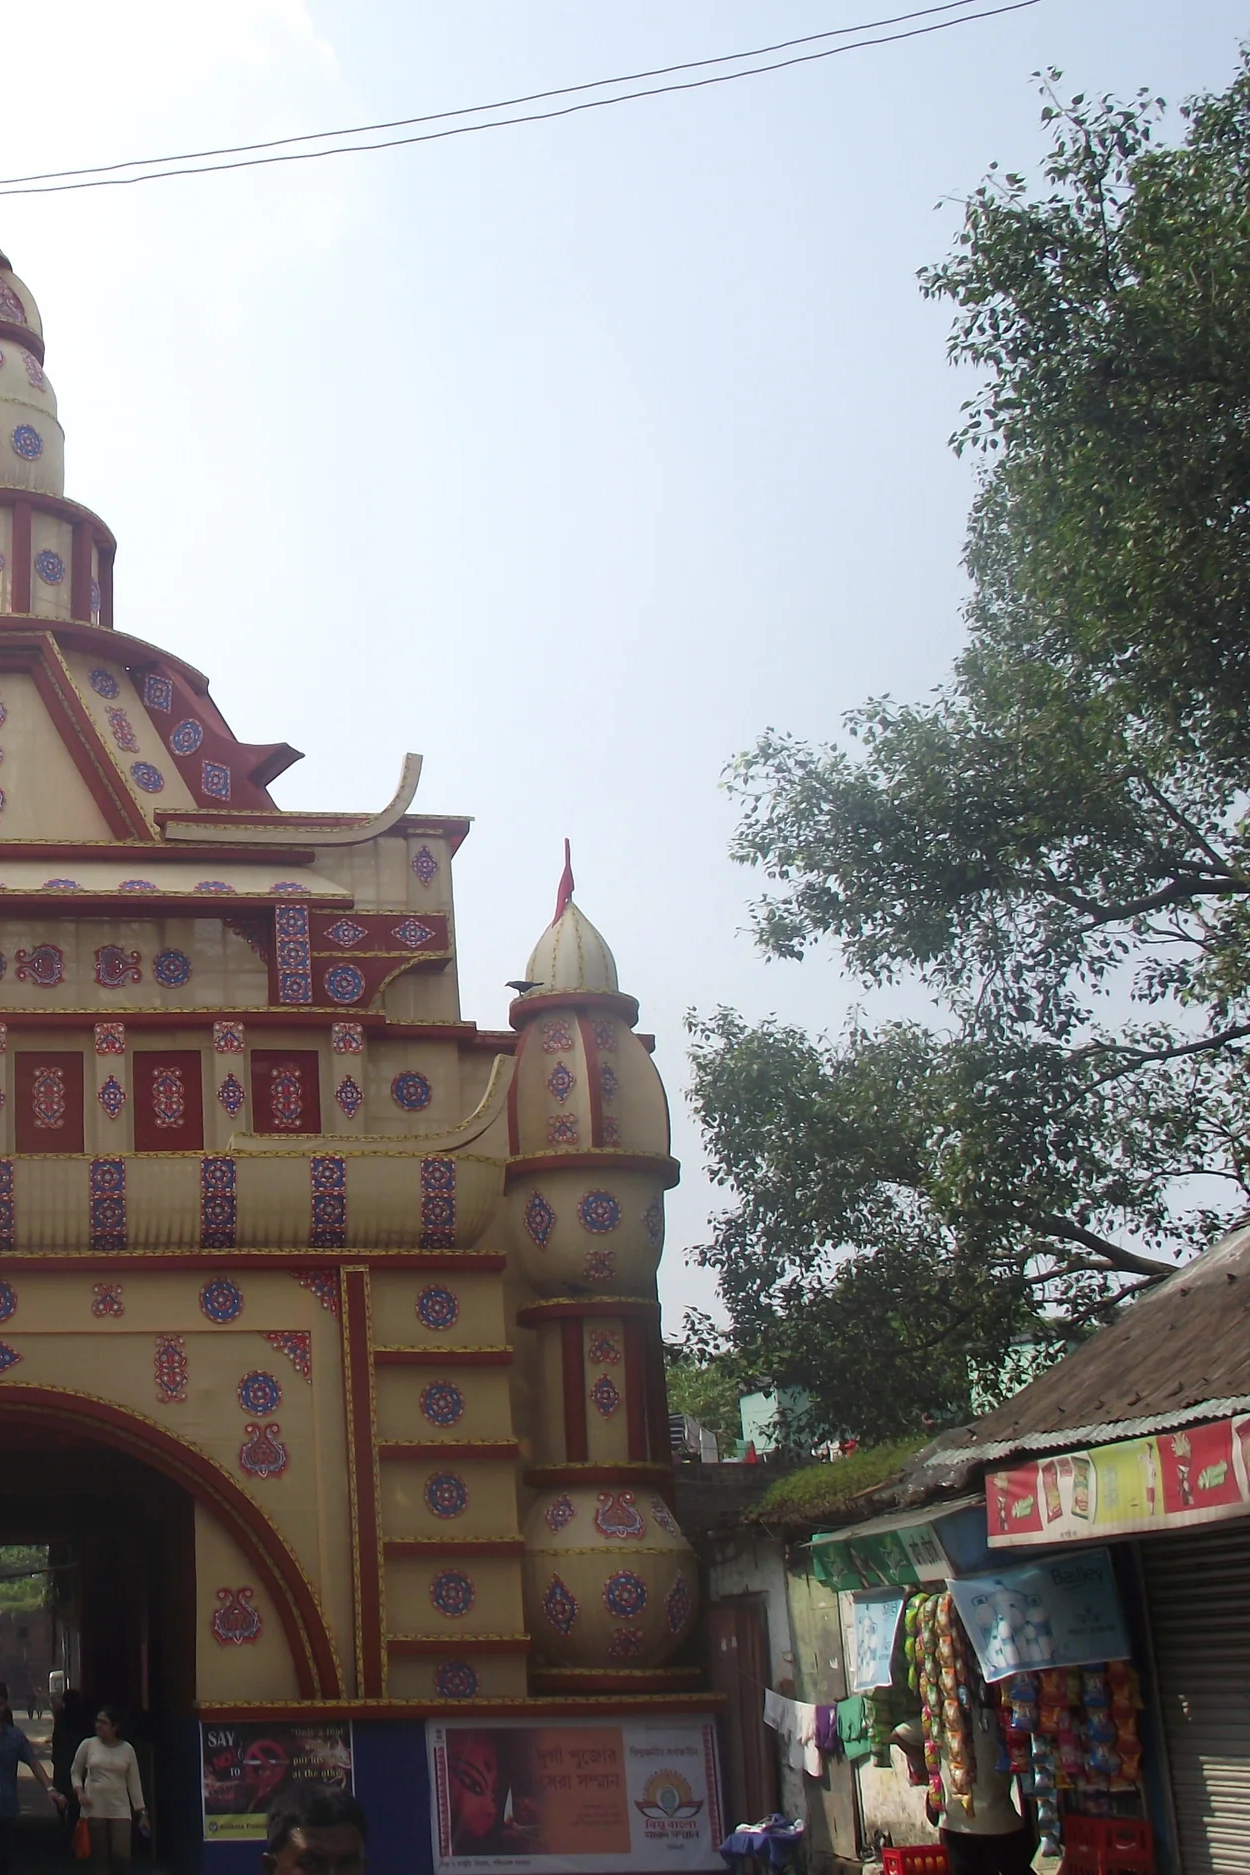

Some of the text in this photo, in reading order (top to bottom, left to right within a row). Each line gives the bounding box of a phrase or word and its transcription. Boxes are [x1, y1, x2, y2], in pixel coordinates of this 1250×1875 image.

[1051, 1565, 1103, 1586] Bailley
[208, 1731, 234, 1747] SAY
[292, 1756, 307, 1766] put
[292, 1770, 301, 1778] at
[304, 1769, 317, 1777] the
